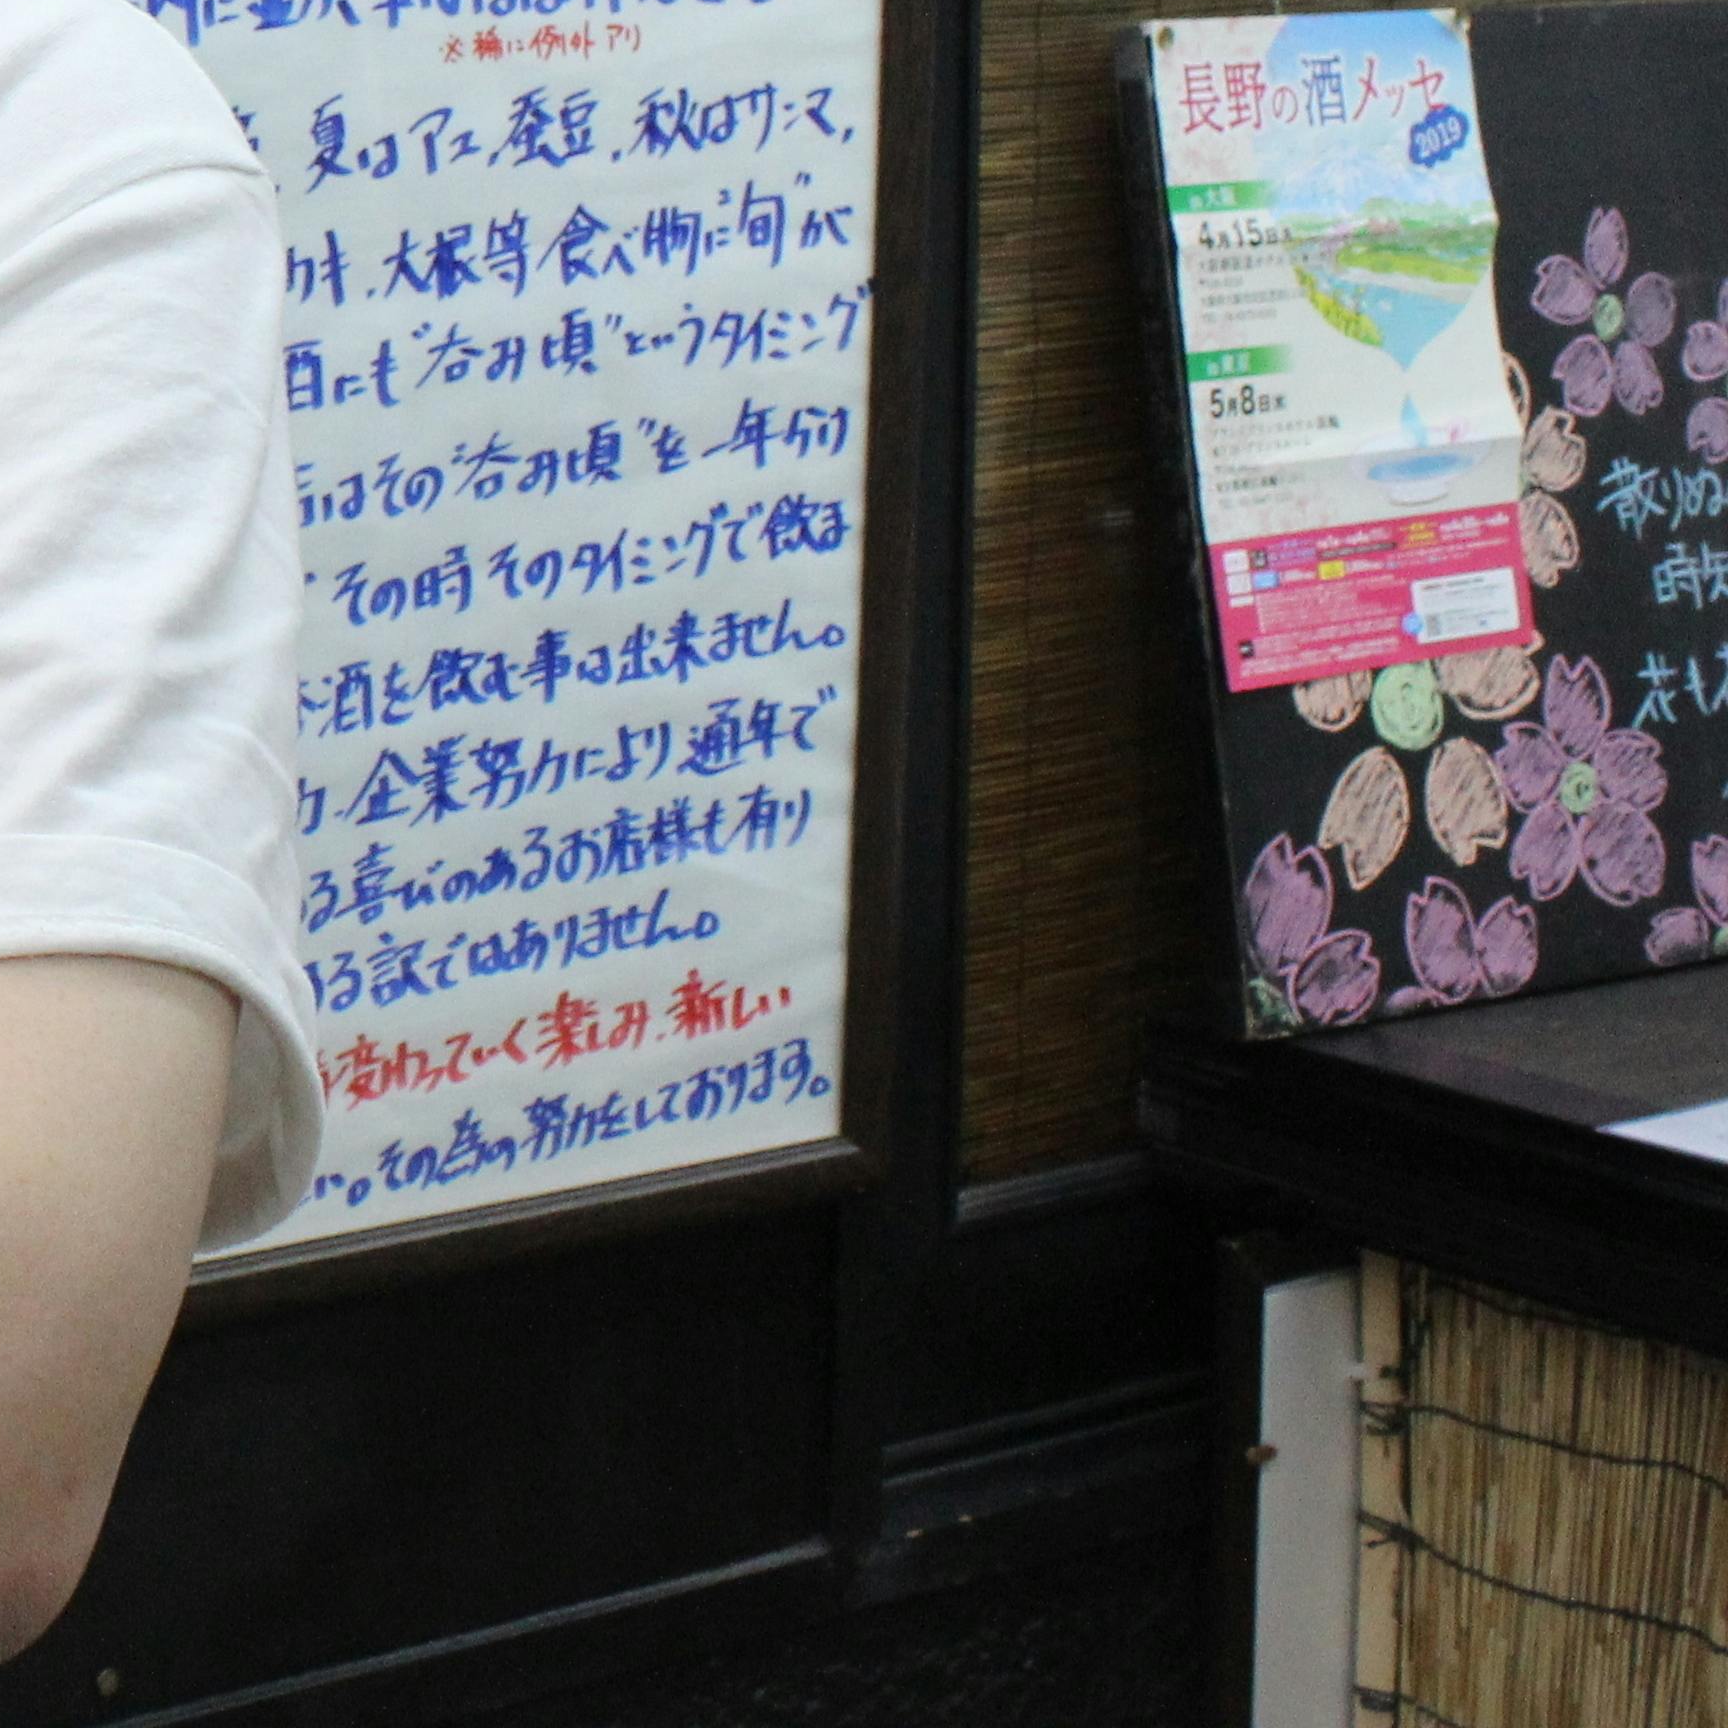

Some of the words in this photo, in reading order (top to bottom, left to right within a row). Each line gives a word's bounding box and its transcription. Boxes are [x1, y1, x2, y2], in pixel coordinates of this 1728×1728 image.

[1179, 54, 1445, 137] 長野の酒メッセ
[1416, 116, 1466, 158] 2019
